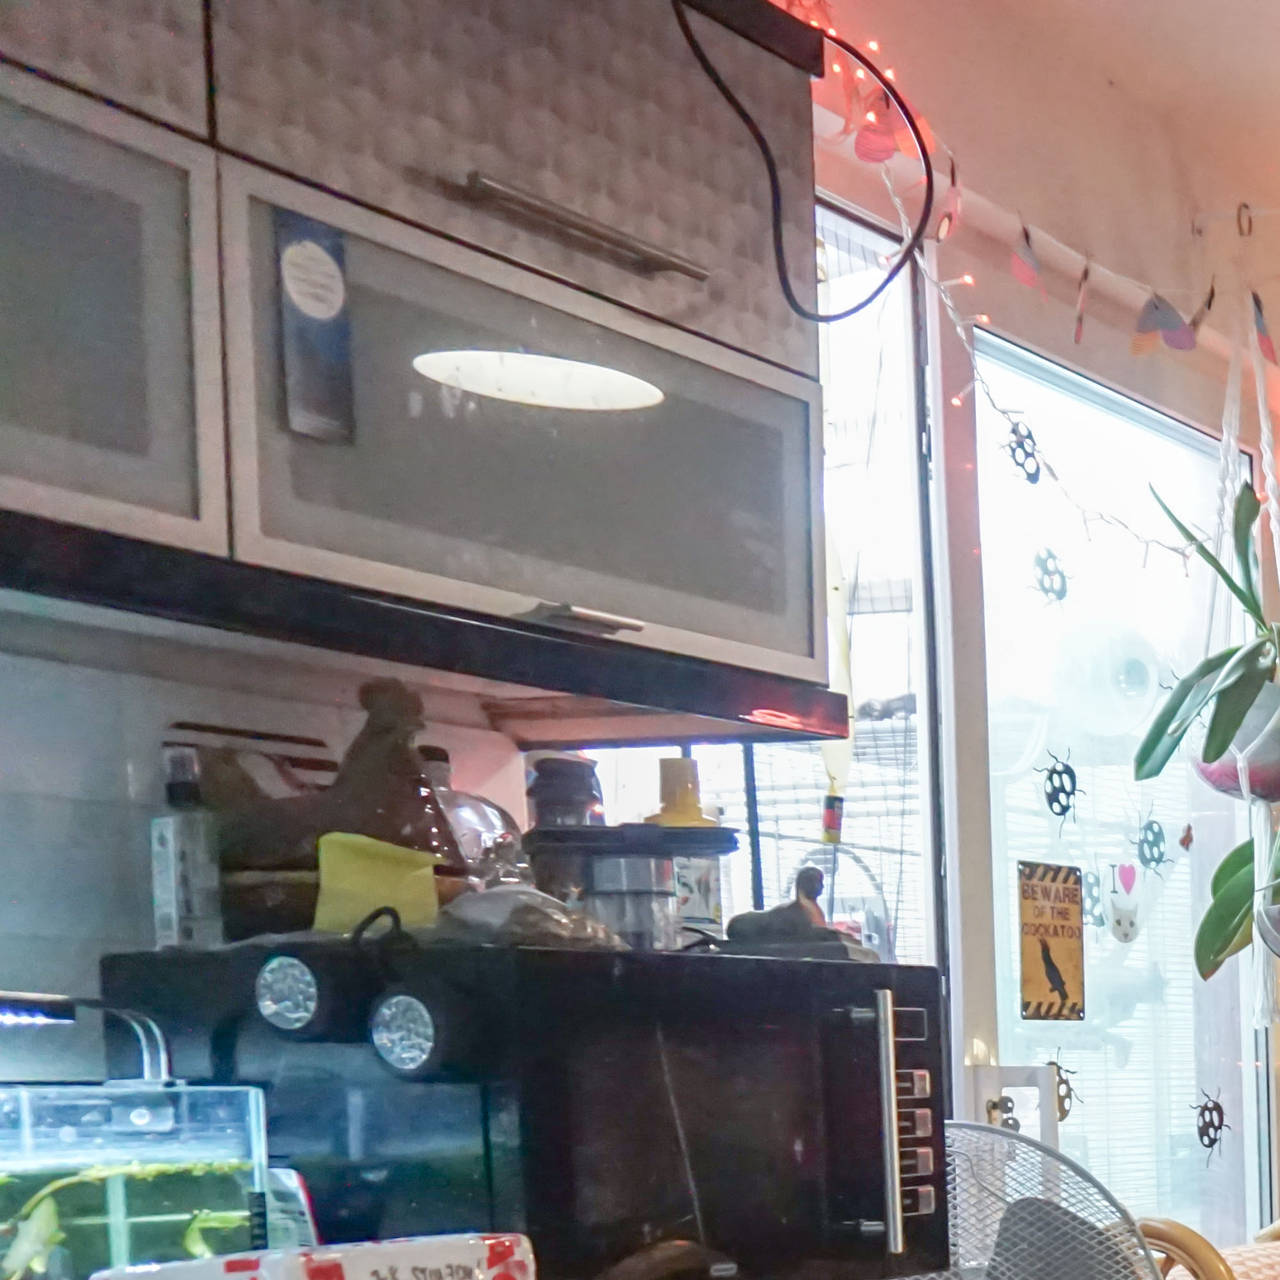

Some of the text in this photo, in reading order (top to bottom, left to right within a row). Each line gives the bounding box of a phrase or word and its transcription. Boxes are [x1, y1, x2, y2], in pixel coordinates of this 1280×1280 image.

[1022, 884, 1079, 904] BEWARE
[1033, 905, 1070, 921] OF THE
[1022, 923, 1081, 938] COCKATOO
